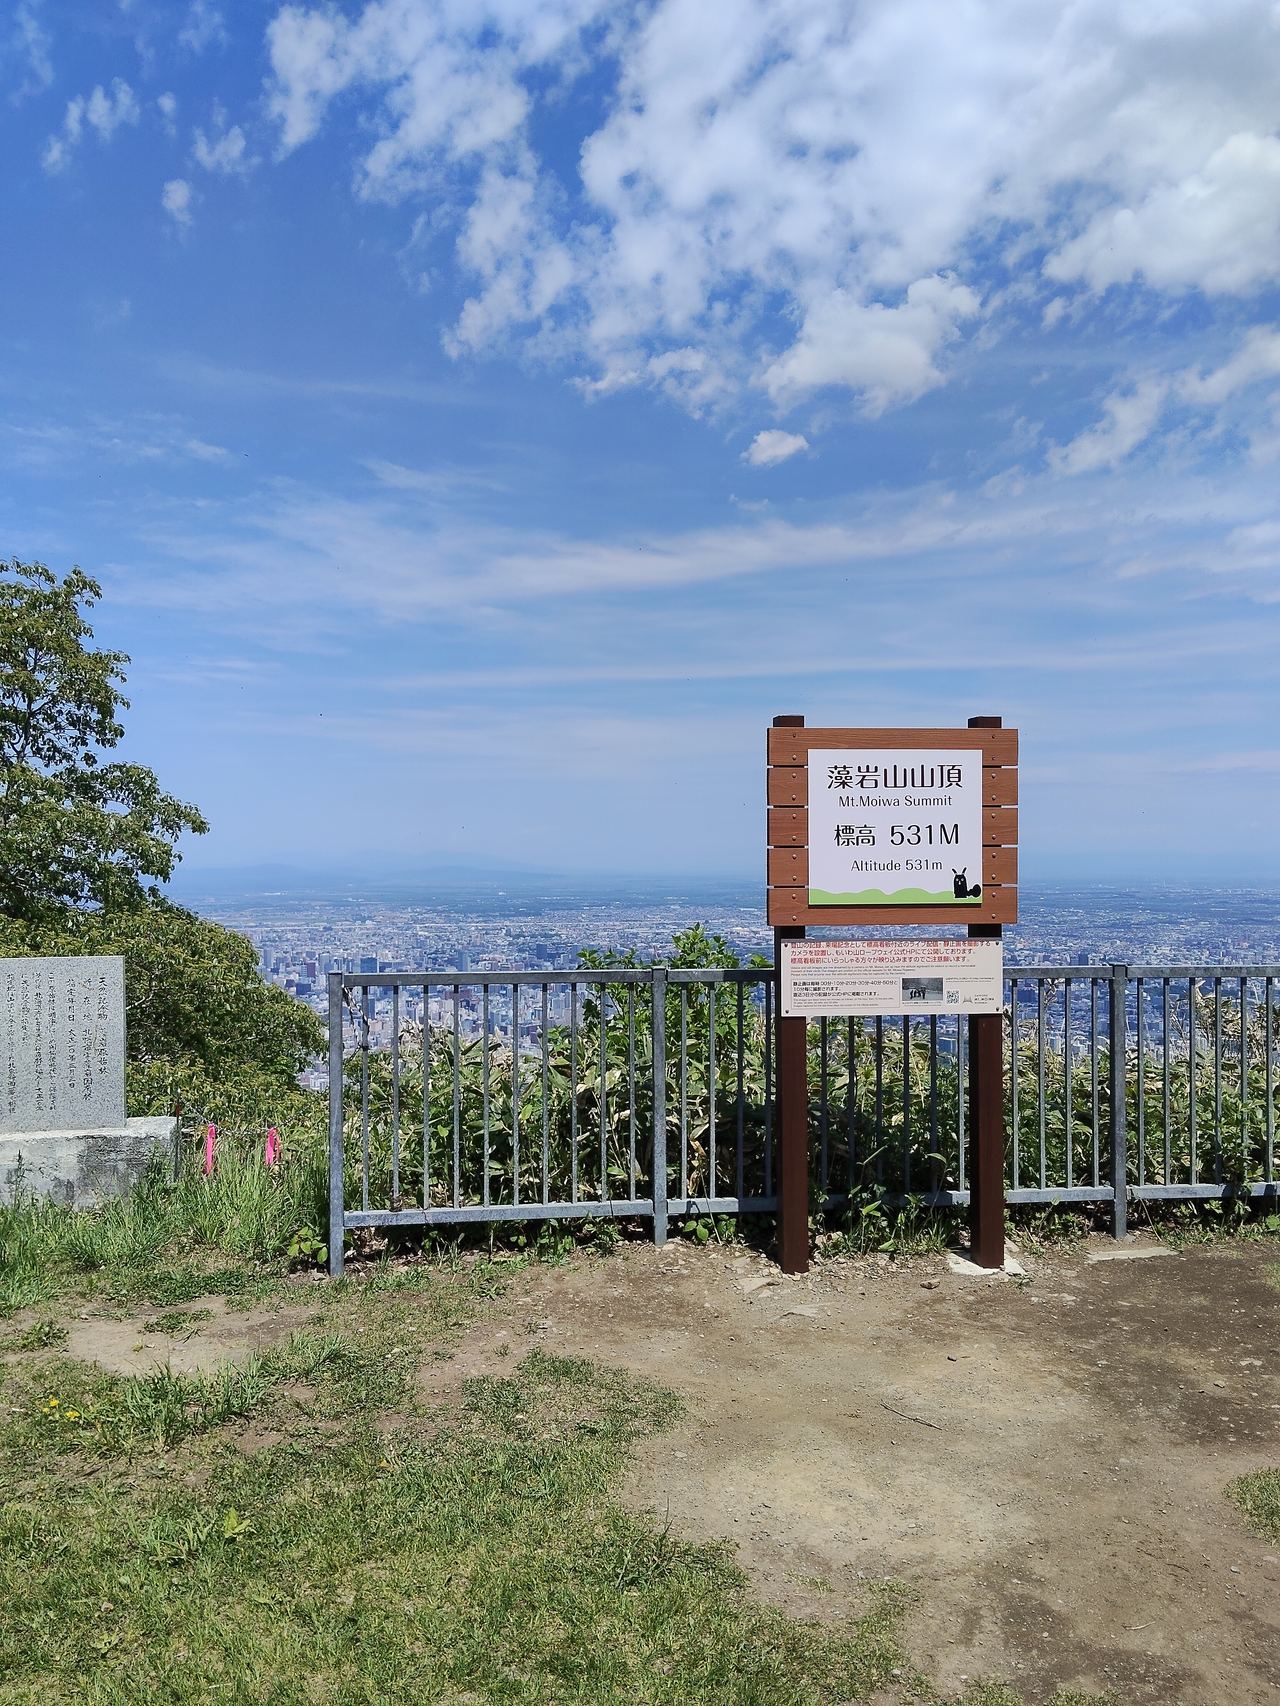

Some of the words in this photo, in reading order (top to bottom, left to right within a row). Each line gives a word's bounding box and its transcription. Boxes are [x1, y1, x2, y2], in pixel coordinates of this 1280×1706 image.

[827, 764, 963, 789] 藻岩山山頂
[838, 796, 900, 807] Mt.Moiwa
[904, 795, 952, 807] Summit
[834, 824, 876, 846] 標高
[890, 824, 959, 845] 531M
[851, 859, 901, 872] Altitude
[906, 859, 943, 871] 531m
